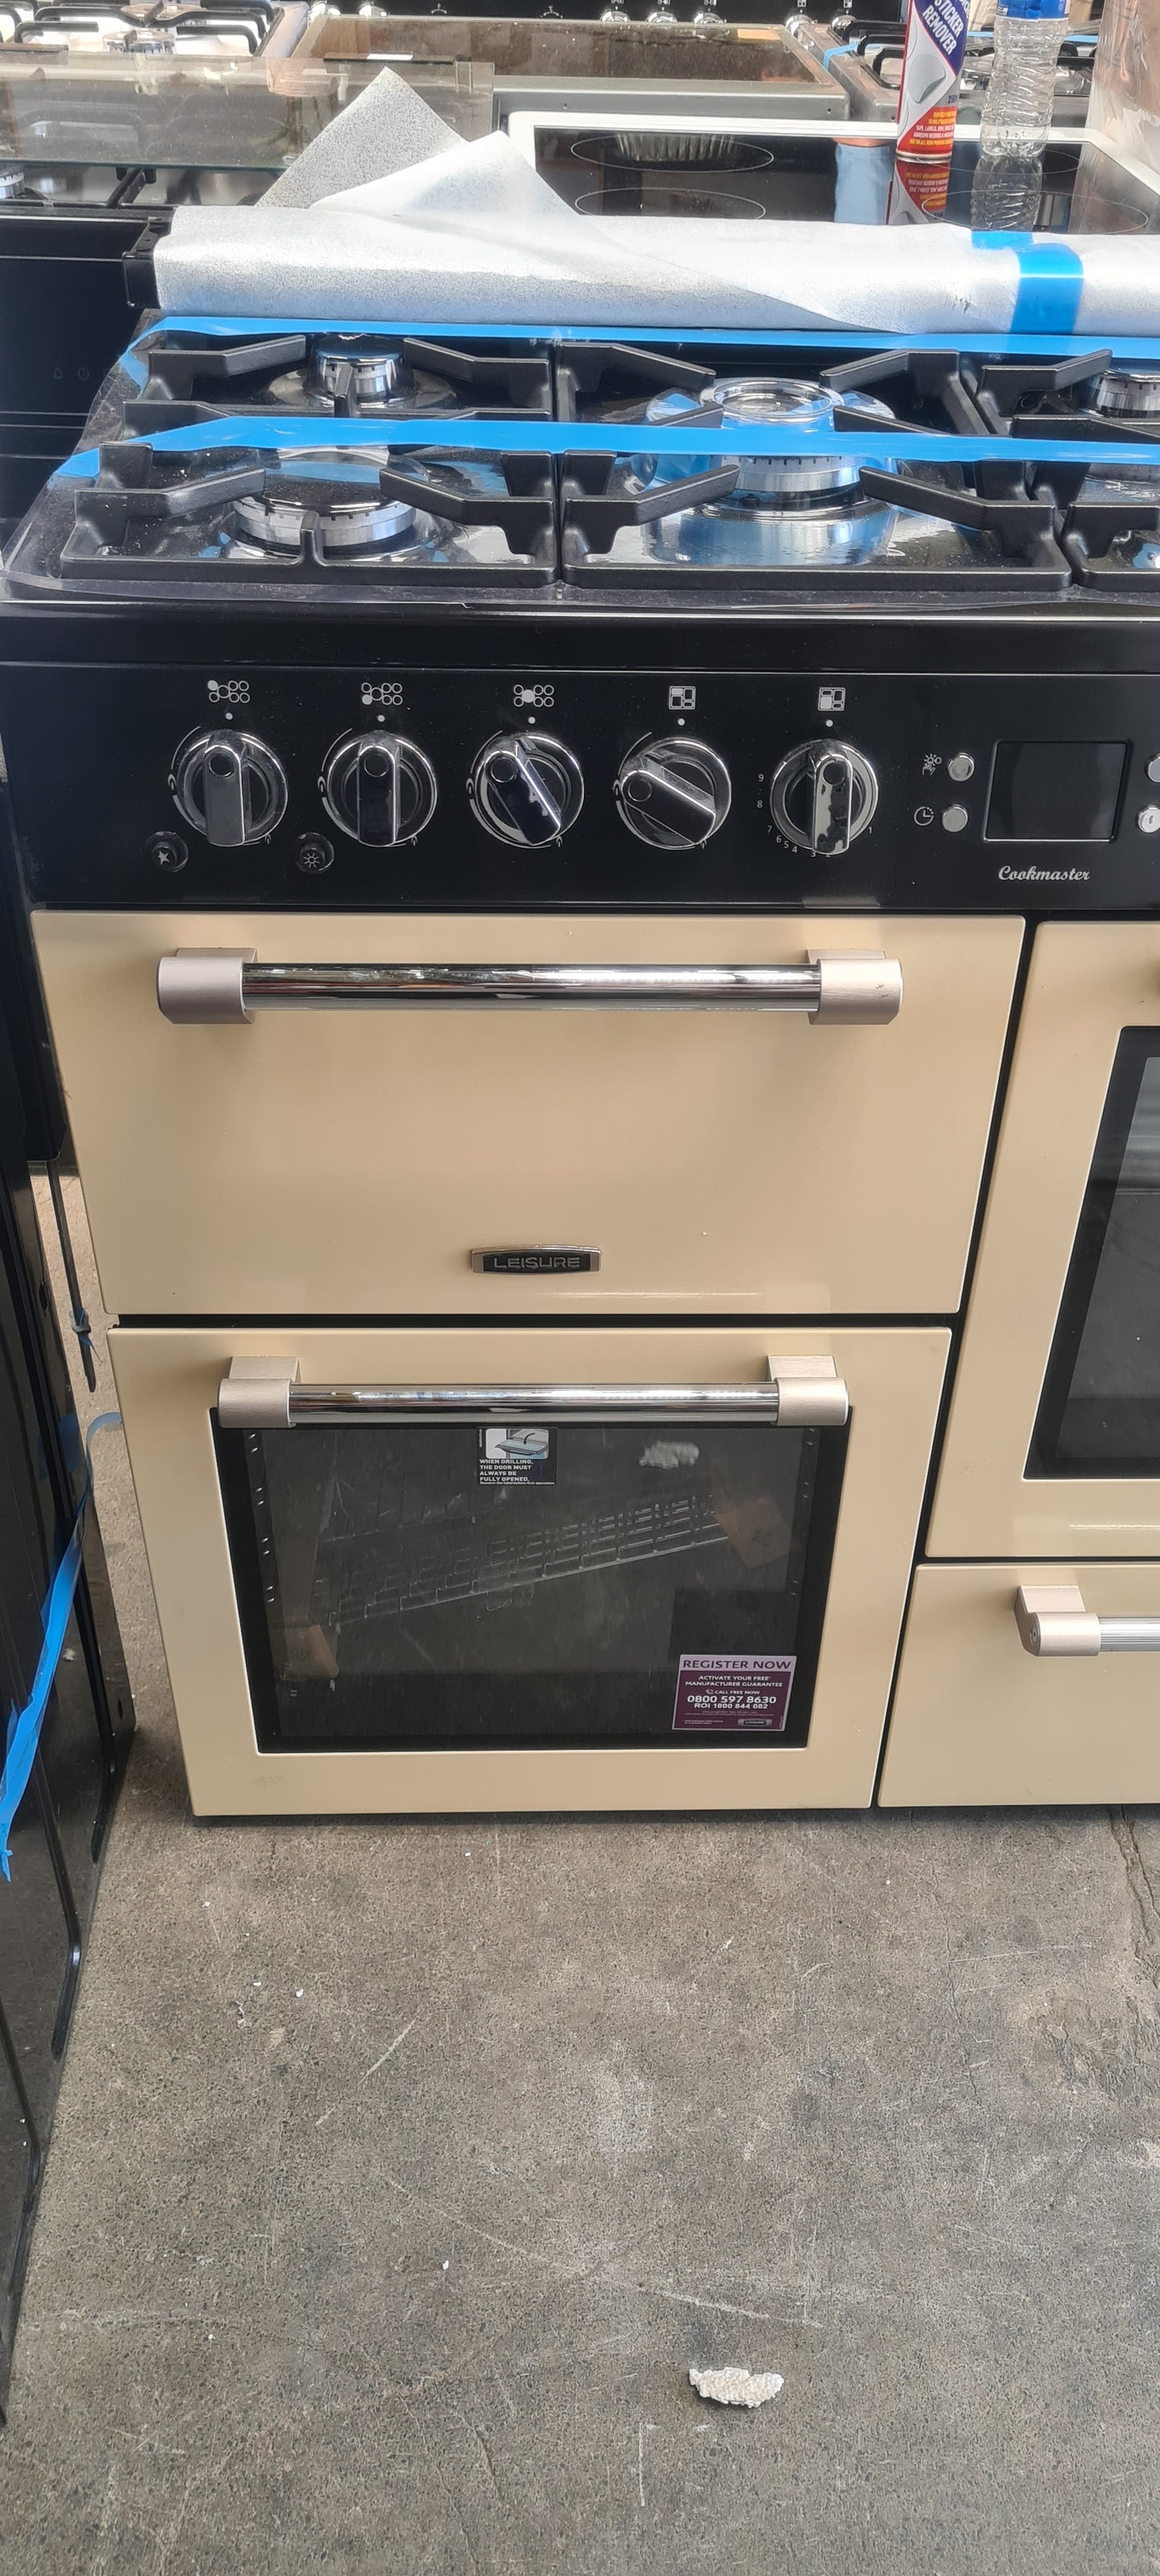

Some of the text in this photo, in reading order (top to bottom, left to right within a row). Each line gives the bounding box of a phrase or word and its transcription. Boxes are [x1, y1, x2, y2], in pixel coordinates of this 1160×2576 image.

[922, 5, 957, 55] REMOVER
[757, 800, 763, 808] 8
[998, 865, 1090, 881] Cookmaster
[494, 1257, 580, 1270] LEISURE
[683, 1660, 792, 1669] REGISTER NOW
[687, 1695, 777, 1704] 0800 597 8630
